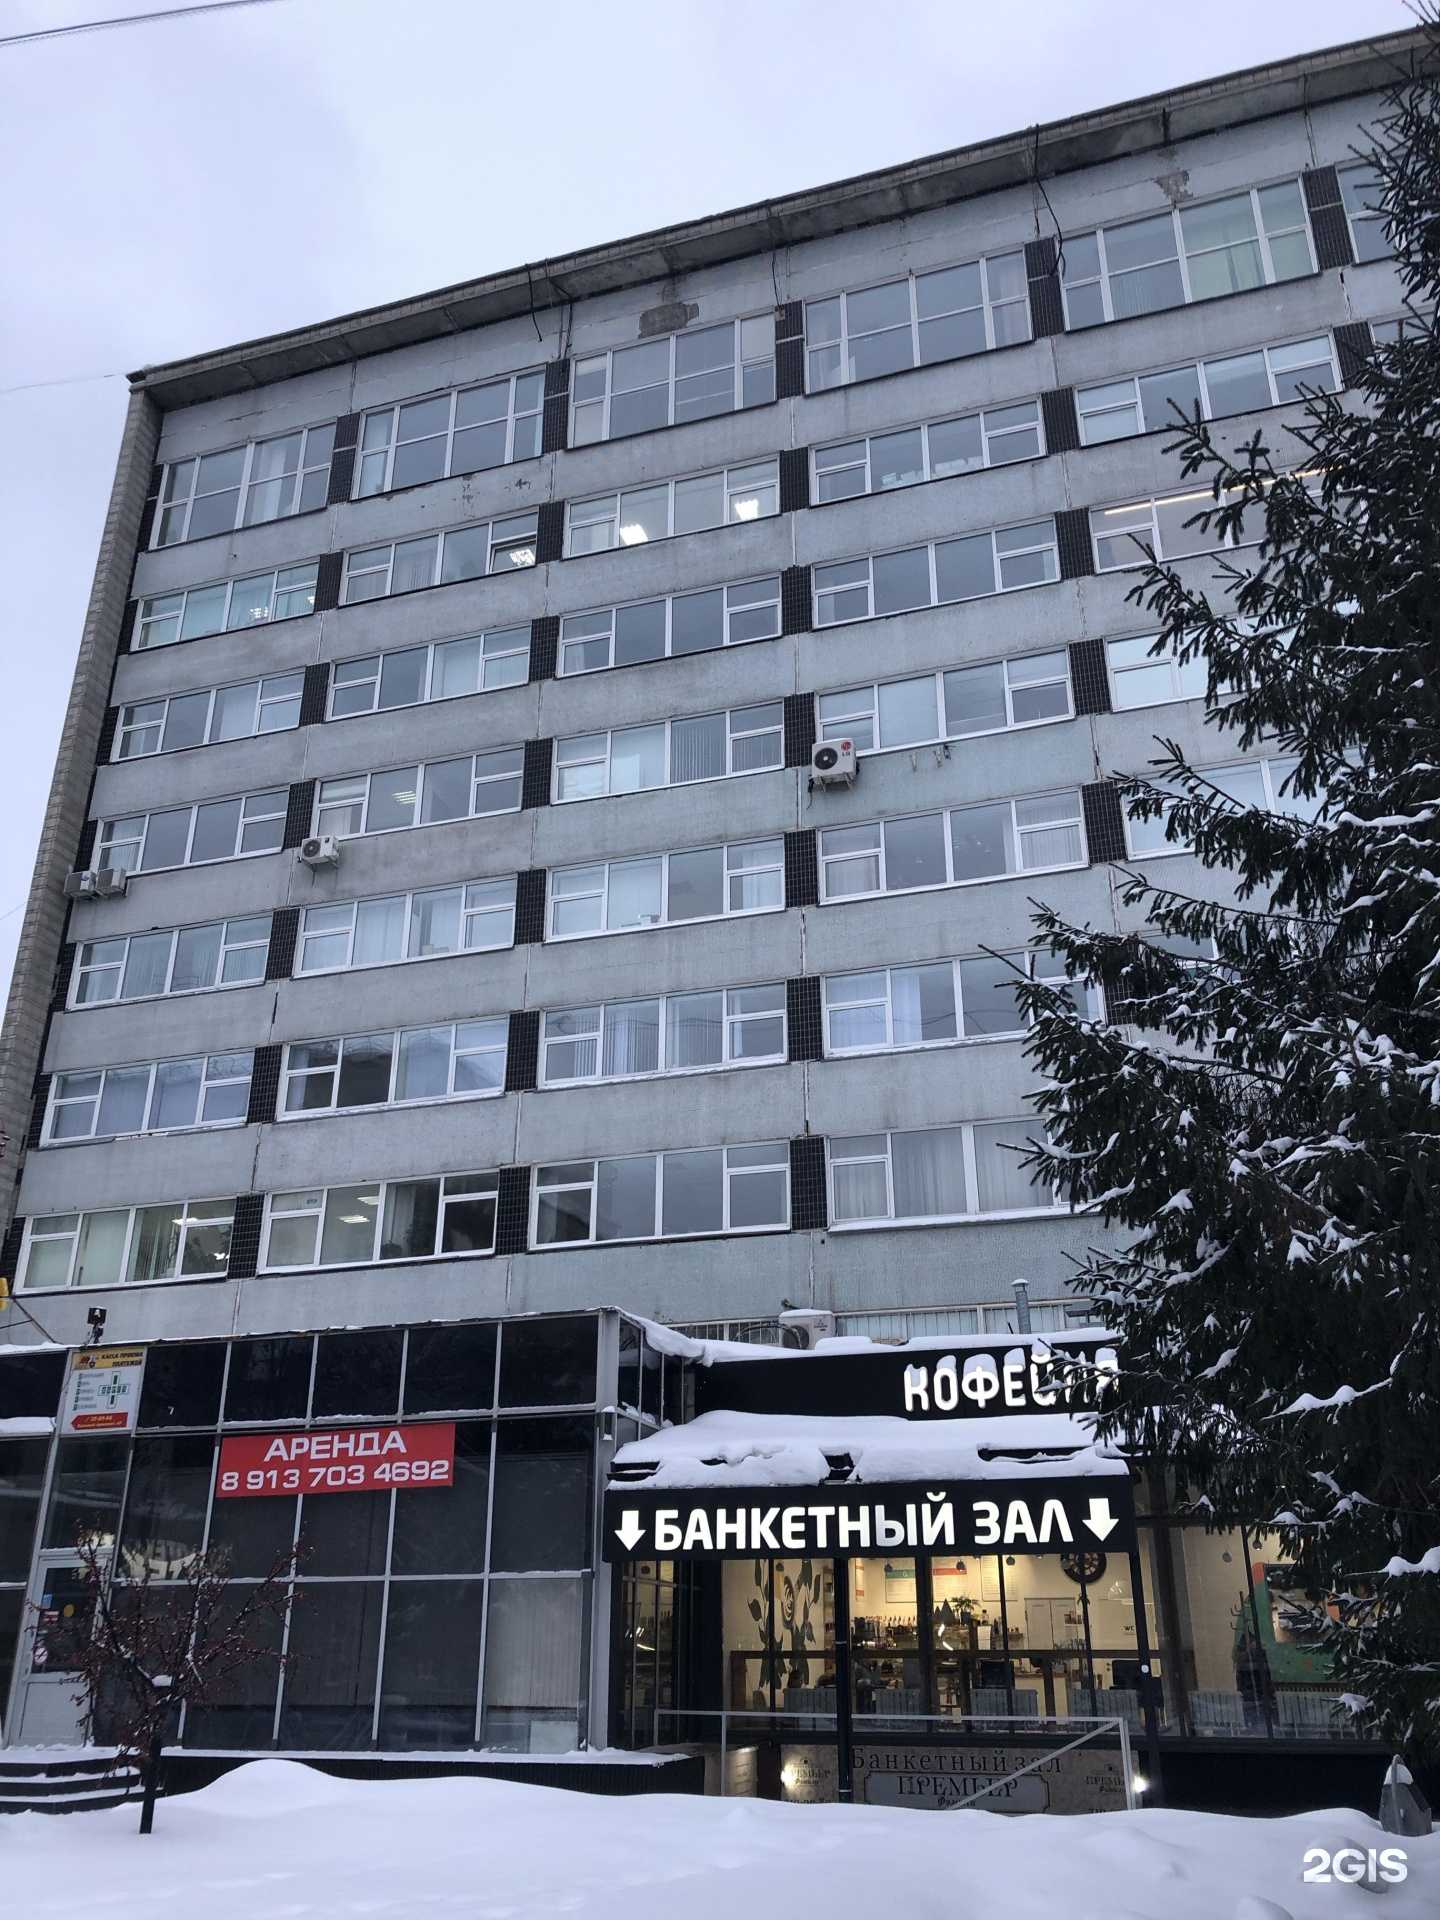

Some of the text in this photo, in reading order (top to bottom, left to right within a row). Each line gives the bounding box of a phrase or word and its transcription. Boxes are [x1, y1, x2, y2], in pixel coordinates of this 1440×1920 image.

[263, 1430, 407, 1462] АРЕНДА
[221, 1460, 449, 1491] 8 913 703 4692
[654, 1492, 1074, 1551] БАНКЕТНЫЙ ЗАЛ
[852, 1747, 1062, 1773] Банкетный зал
